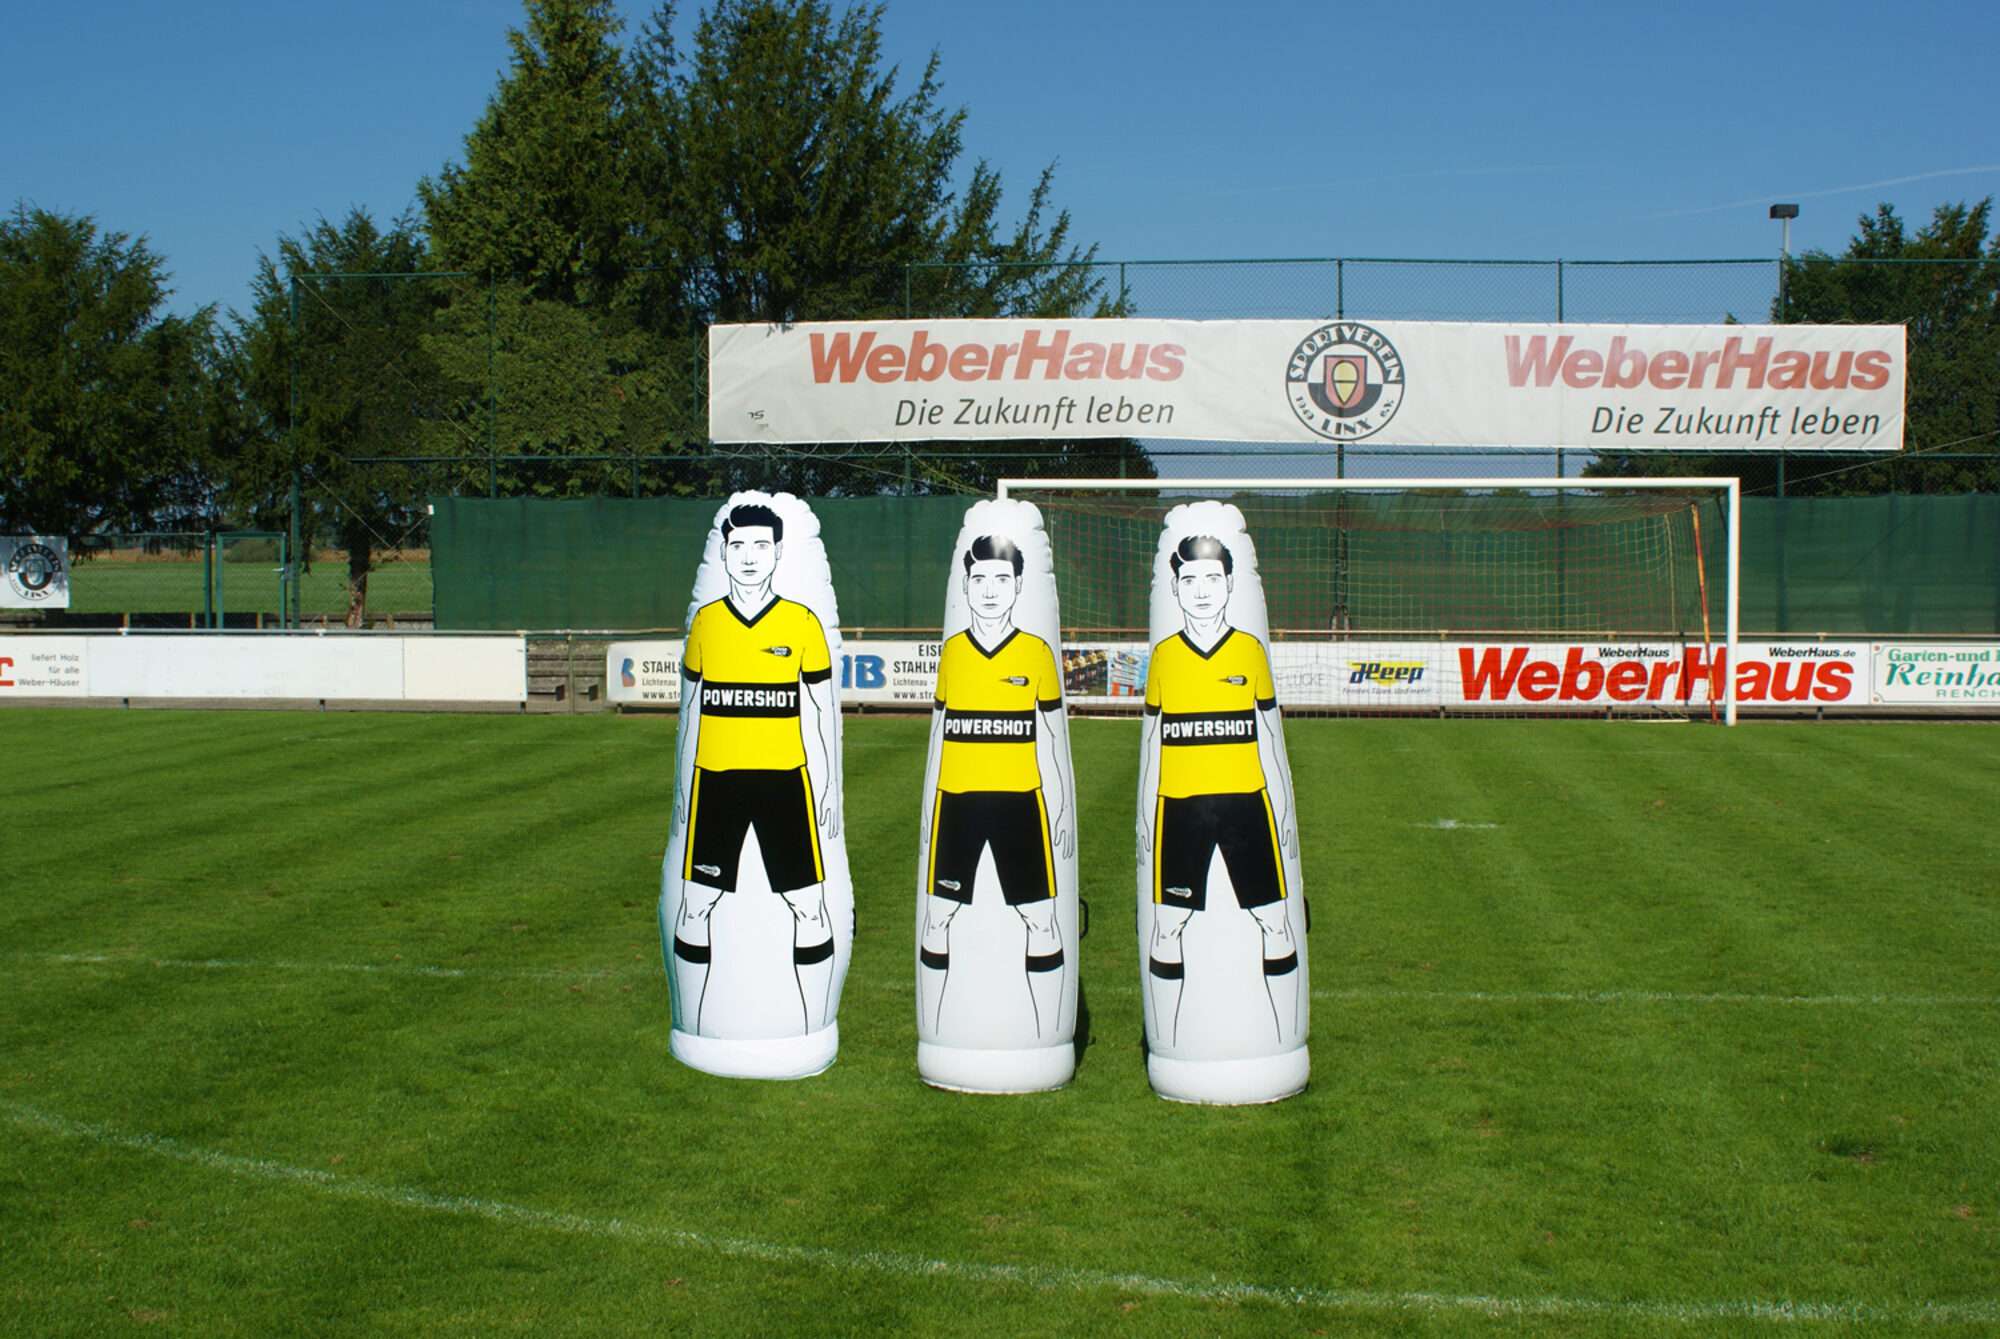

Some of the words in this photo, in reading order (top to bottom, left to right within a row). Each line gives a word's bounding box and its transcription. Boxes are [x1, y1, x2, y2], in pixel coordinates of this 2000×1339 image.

[809, 329, 1186, 384] WeberHaus
[1289, 324, 1401, 382] SPORTVEREIN
[1503, 335, 1892, 391] WeberHaus
[895, 398, 944, 426] Die
[953, 396, 1077, 431] Zukunft
[1086, 396, 1174, 424] leben
[1321, 418, 1373, 435] LINX
[1591, 405, 1644, 434] Die
[1655, 406, 1780, 441] Zukunft
[1791, 406, 1880, 435] leben
[60, 653, 79, 661] Holz
[1598, 647, 1670, 658] WeberHaus
[1769, 647, 1856, 658] WeberHaus.de
[48, 666, 61, 674] für
[64, 666, 80, 674] alle
[642, 661, 680, 673] STAHL
[893, 661, 939, 673] STAHLH
[1458, 647, 1855, 702] WeberHaus
[703, 688, 797, 708] POWERSHOT
[893, 691, 935, 699] www.str
[944, 718, 1033, 736] POWERSHOT
[1162, 719, 1254, 739] POWERSHOT
